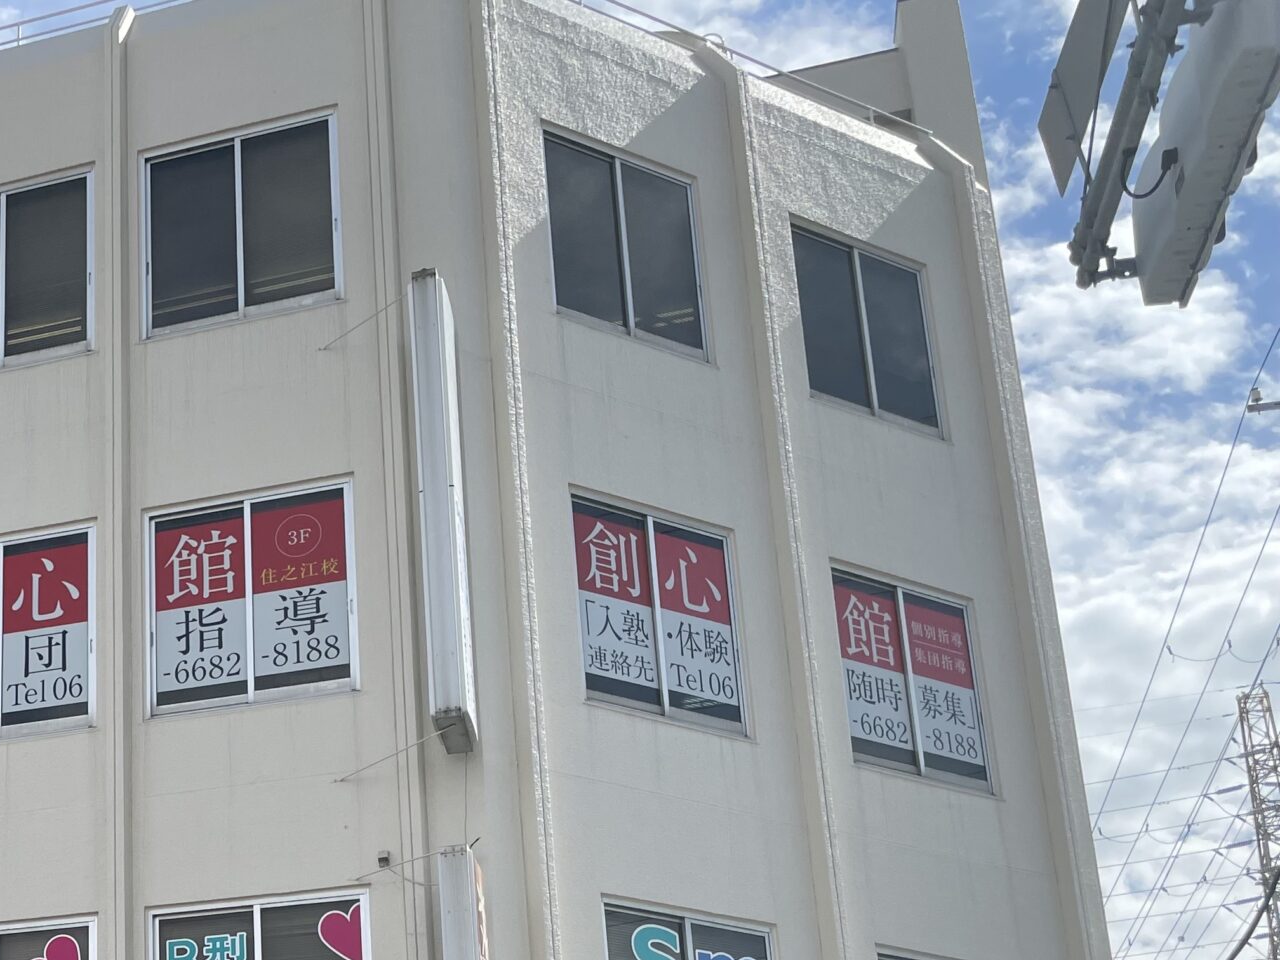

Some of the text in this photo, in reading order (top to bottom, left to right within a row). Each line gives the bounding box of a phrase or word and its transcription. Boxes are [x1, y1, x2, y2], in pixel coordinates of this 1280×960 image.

[287, 528, 312, 546] 3F
[261, 558, 339, 585] 住之江校
[587, 645, 654, 683] 連絡先
